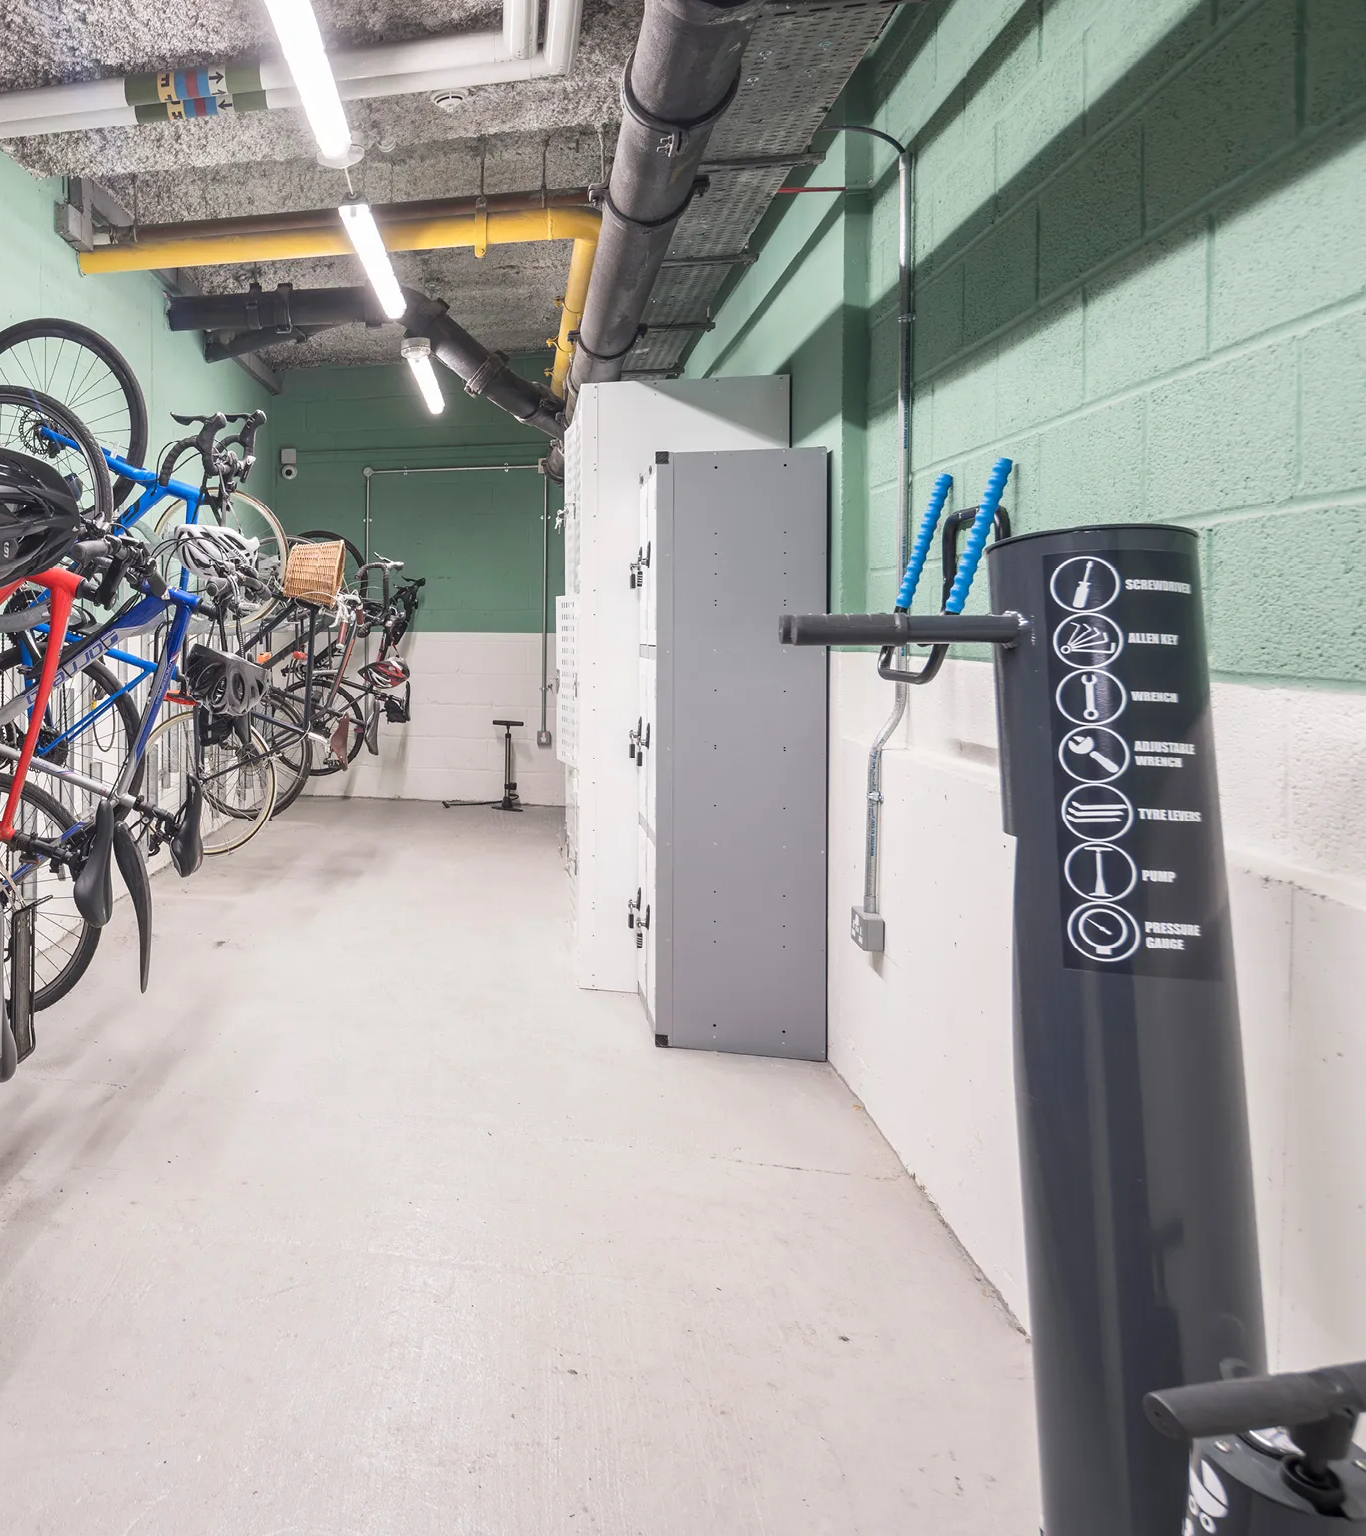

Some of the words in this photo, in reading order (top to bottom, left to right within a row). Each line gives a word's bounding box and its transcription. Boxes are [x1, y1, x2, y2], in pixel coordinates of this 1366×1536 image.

[1124, 578, 1192, 595] SCREWDRIVER
[1128, 632, 1160, 644] ALLEN
[1160, 634, 1179, 646] KEY
[1130, 690, 1179, 703] WRENCH
[1133, 740, 1196, 755] ADJUSTABLE
[1135, 755, 1183, 768] WRENCH
[1137, 807, 1167, 821] TYRE
[1168, 809, 1202, 823] LEVERS
[1141, 869, 1177, 883] PUMP
[1144, 921, 1202, 937] PRESSURE
[1145, 936, 1185, 951] GAUGE
